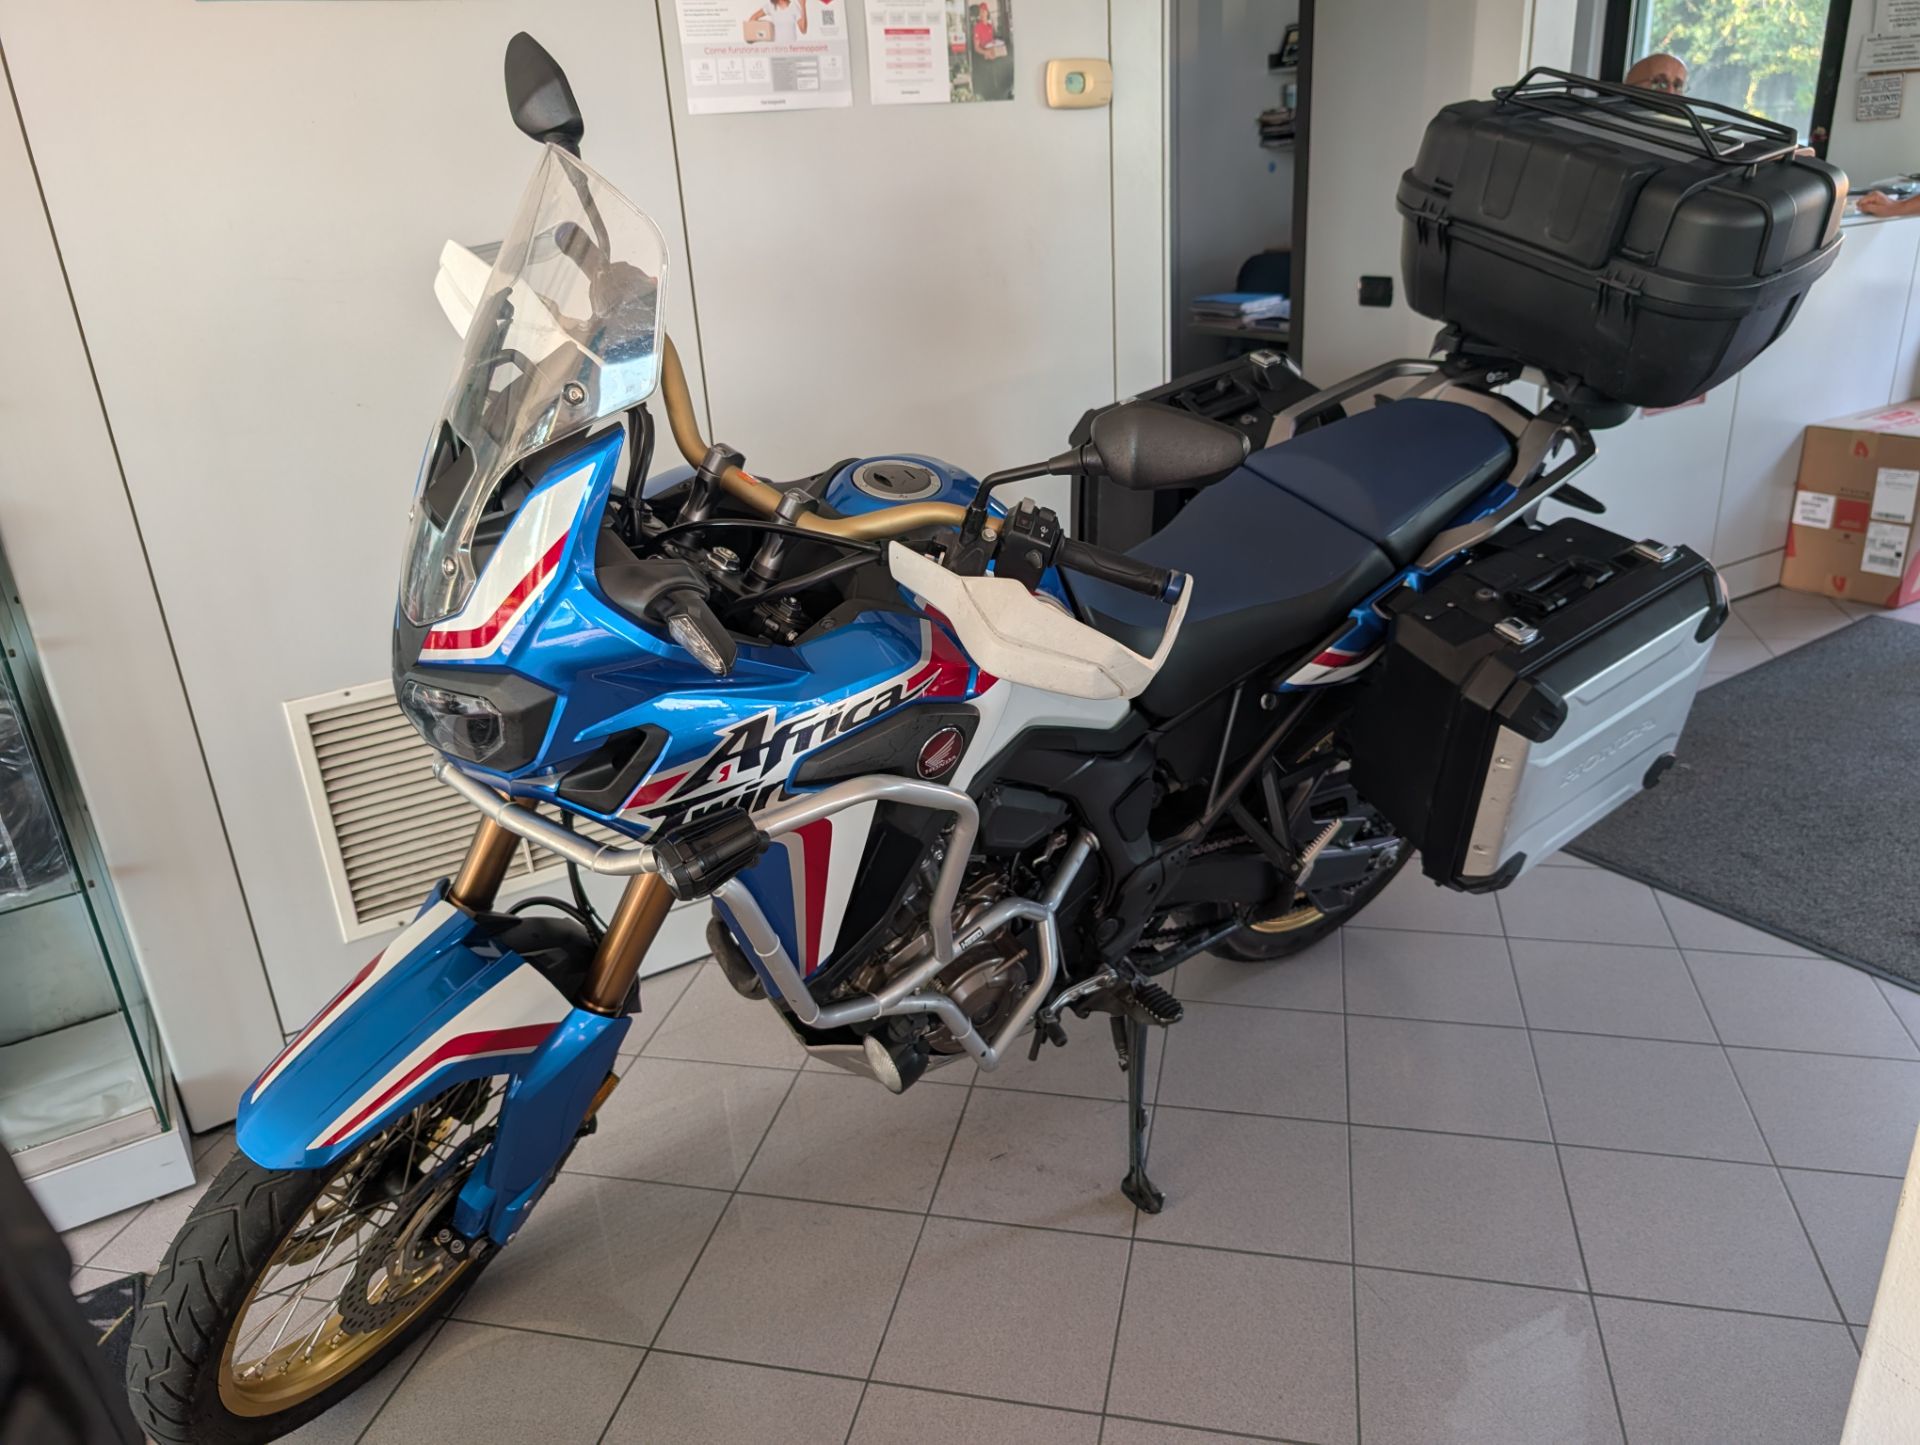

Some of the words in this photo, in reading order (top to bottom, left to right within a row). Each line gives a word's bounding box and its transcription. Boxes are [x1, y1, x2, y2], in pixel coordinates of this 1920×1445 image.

[703, 46, 727, 56] Come
[727, 45, 759, 56] funziona
[789, 44, 828, 55] fermopoint
[667, 676, 935, 803] Africa
[924, 754, 957, 775] HONDA
